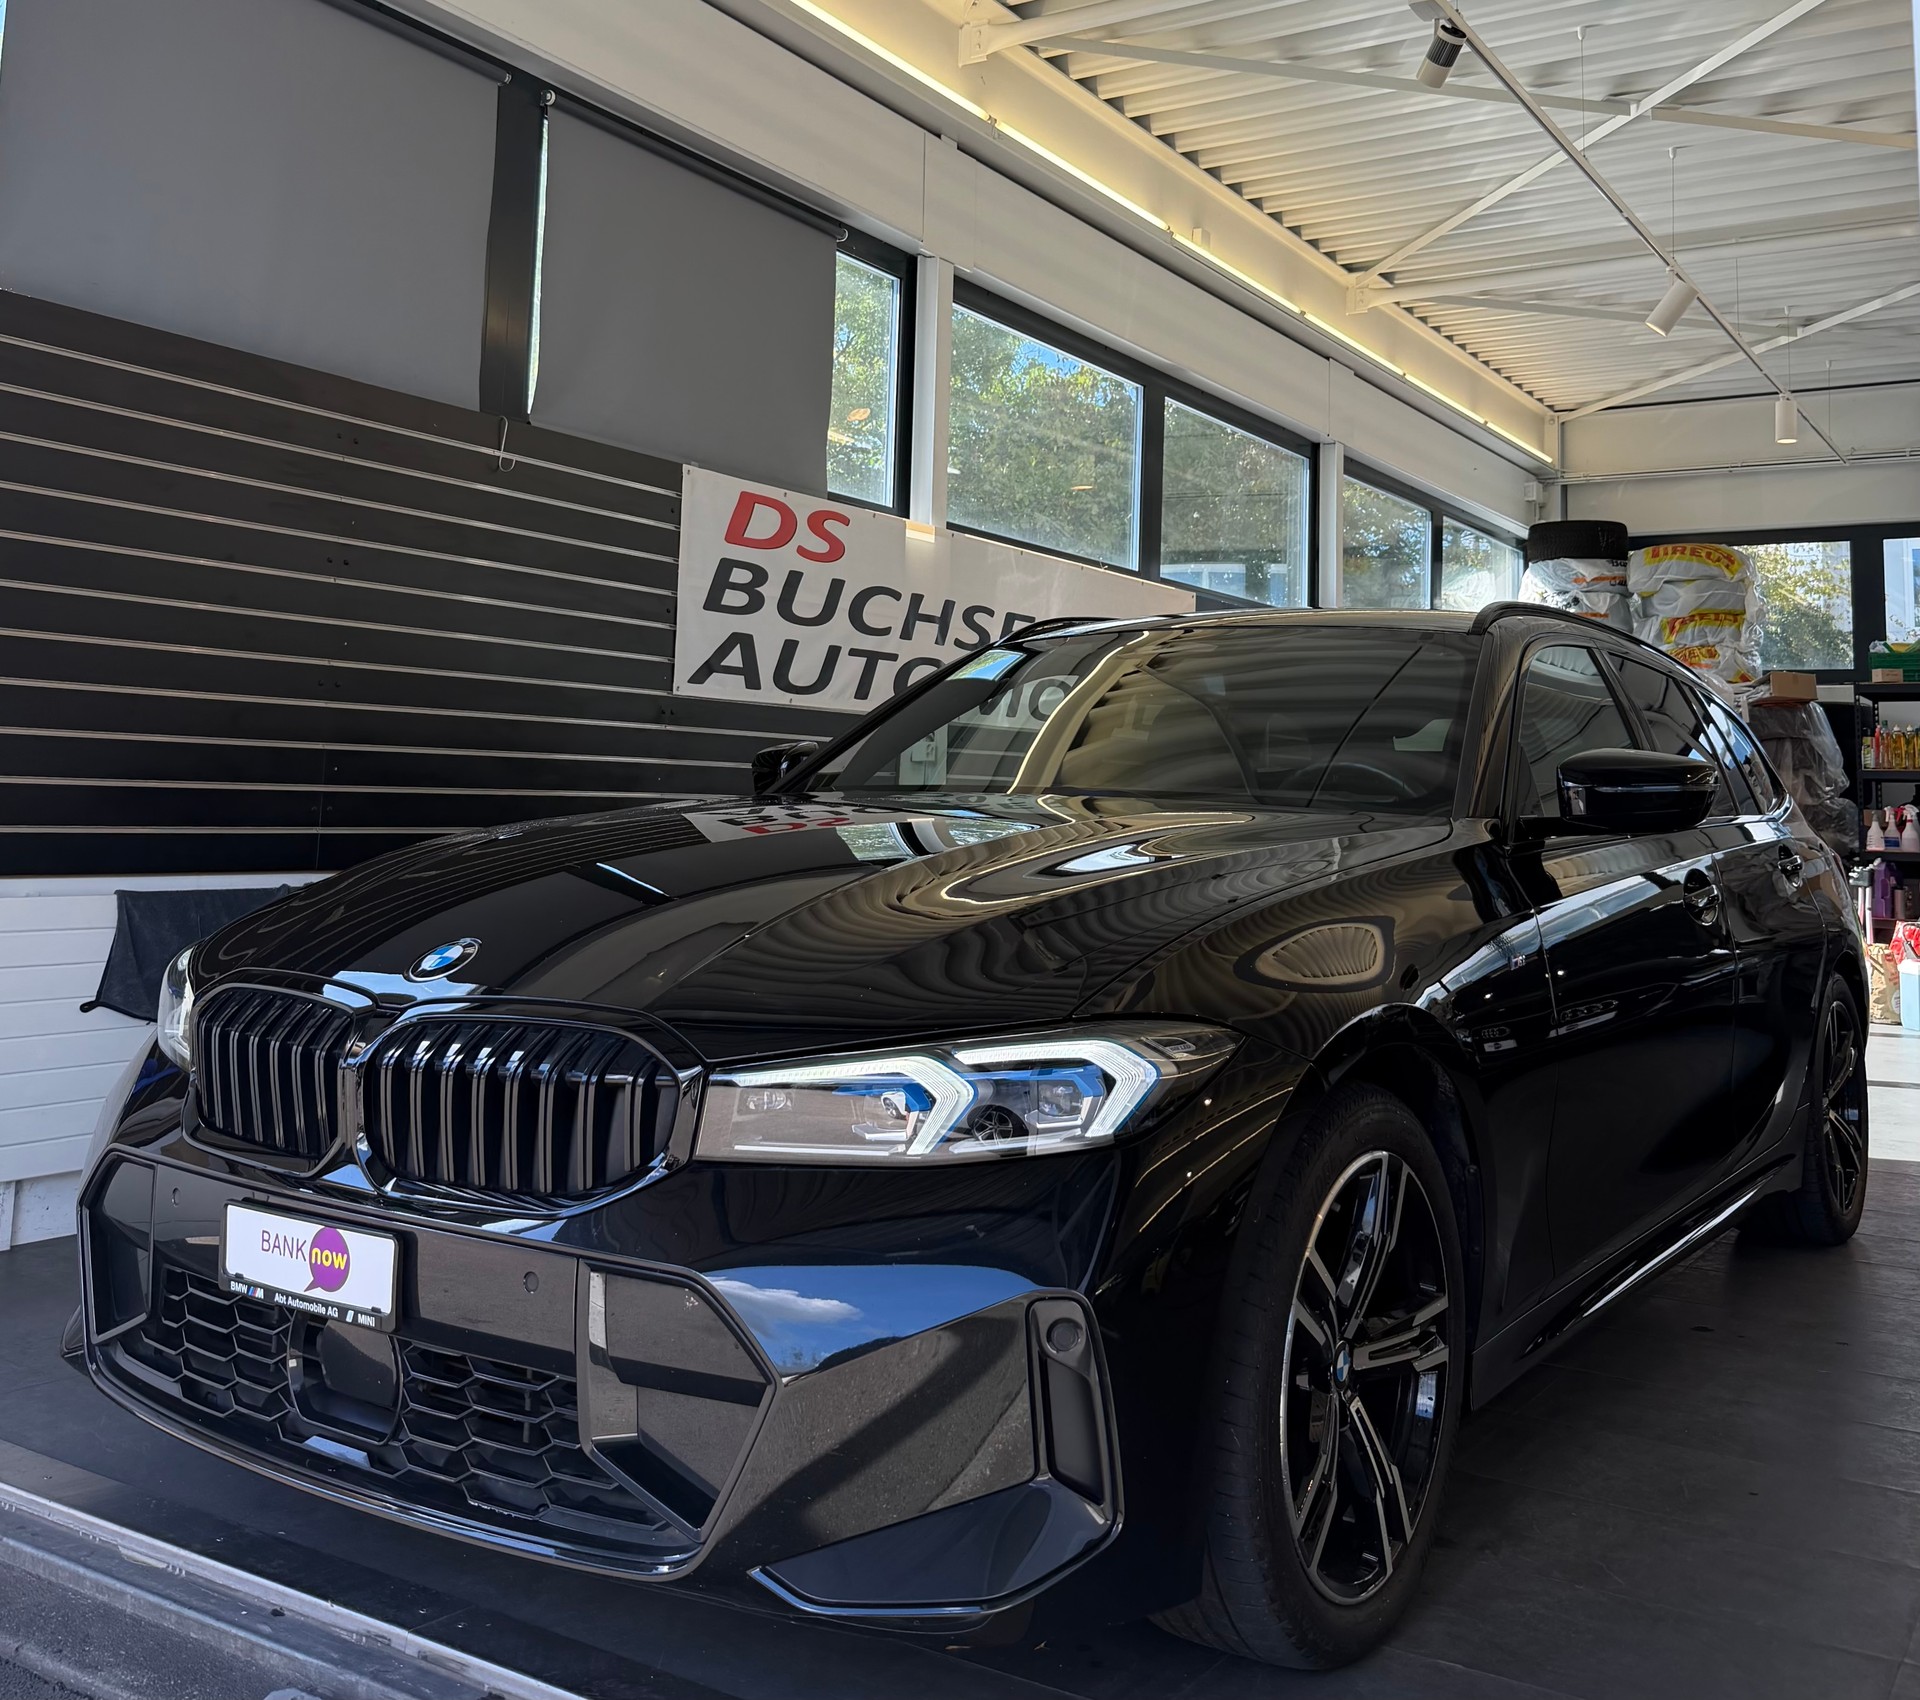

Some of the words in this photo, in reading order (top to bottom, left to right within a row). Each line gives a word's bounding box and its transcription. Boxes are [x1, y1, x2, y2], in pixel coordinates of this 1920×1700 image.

[724, 490, 850, 563] DS
[261, 1229, 307, 1262] BANK
[311, 1247, 348, 1270] now
[230, 1281, 248, 1294] BMW
[274, 1292, 287, 1305] Abt
[288, 1296, 326, 1315] Automobile
[327, 1306, 339, 1318] AG
[357, 1313, 376, 1327] MINI
